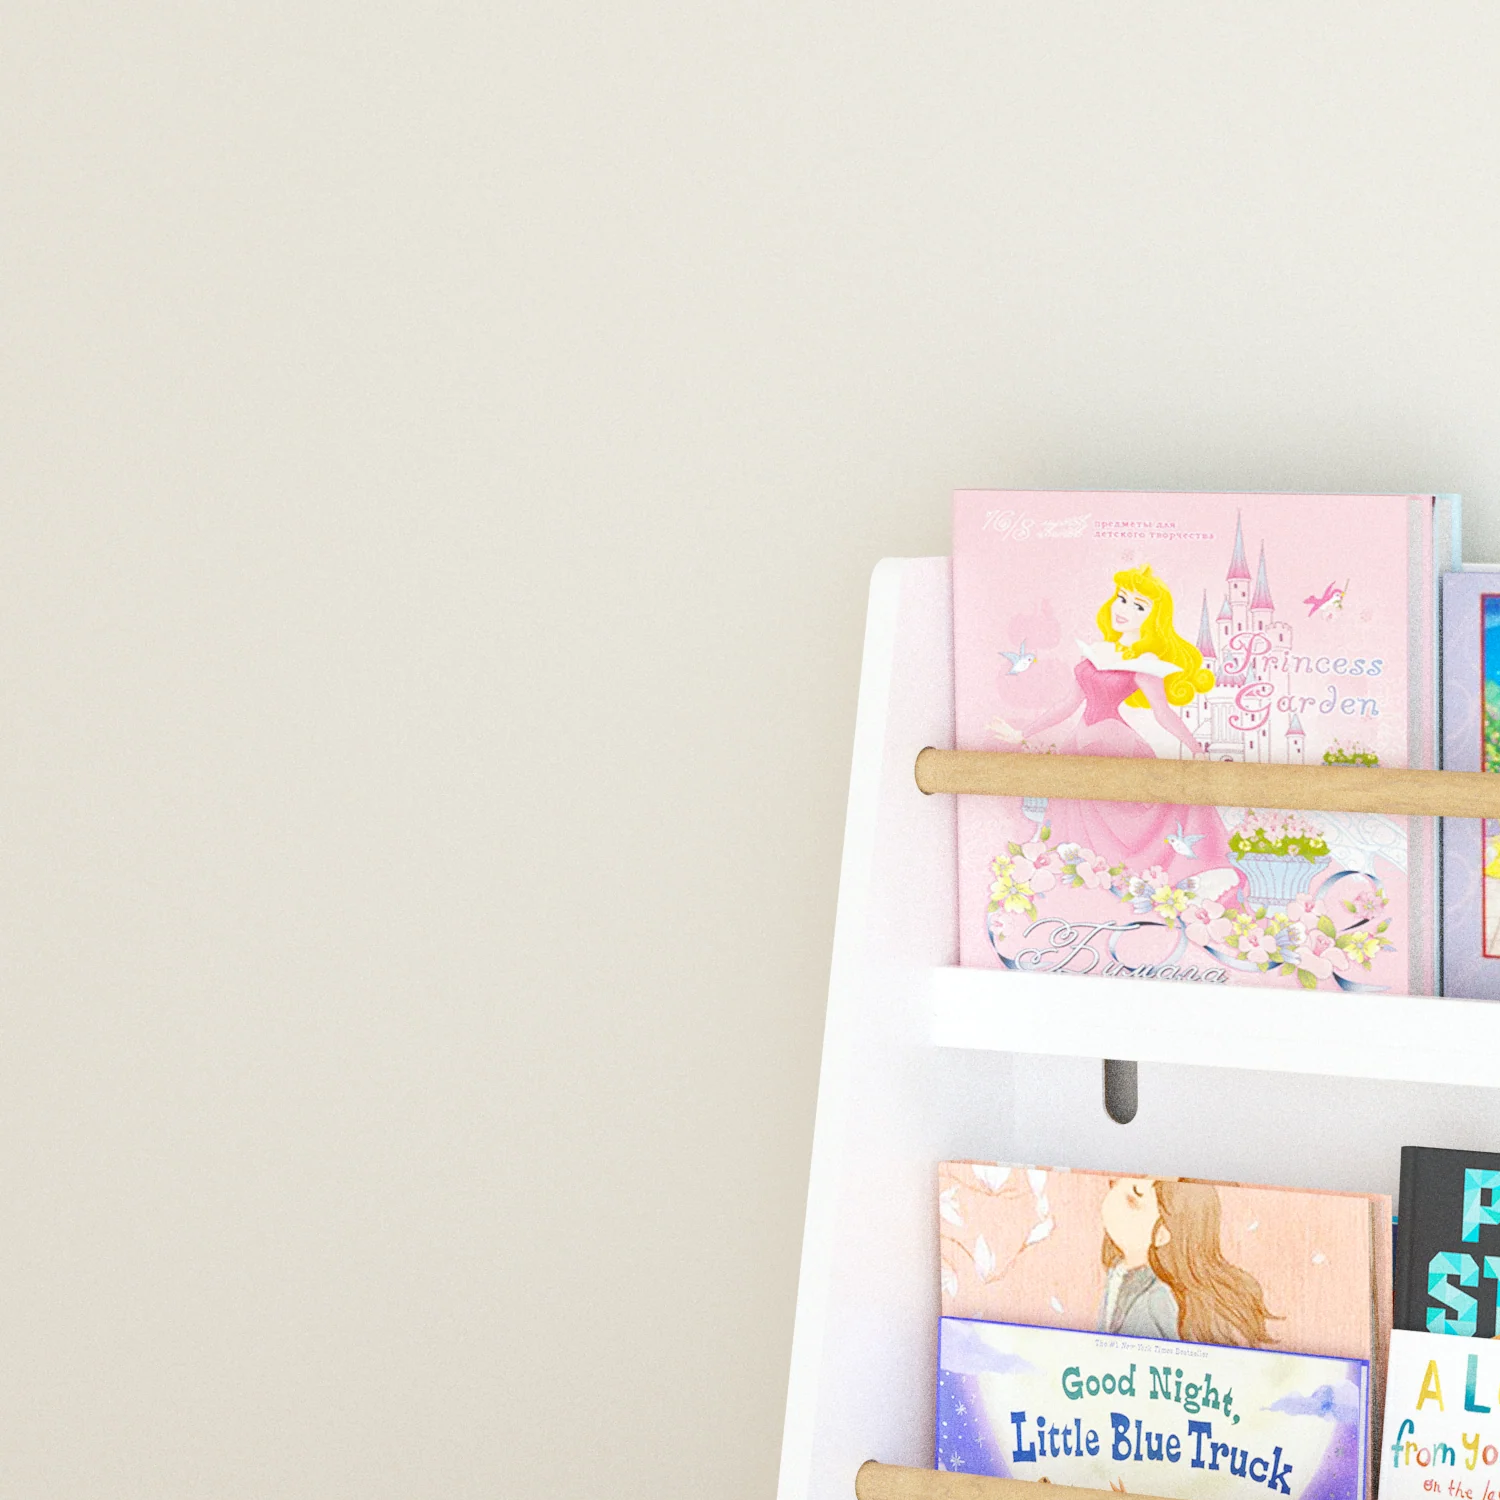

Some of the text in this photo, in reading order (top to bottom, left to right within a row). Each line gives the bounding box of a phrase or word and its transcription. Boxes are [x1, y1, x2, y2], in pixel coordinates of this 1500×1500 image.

[1223, 632, 1384, 676] Princess
[1228, 682, 1380, 731] Garden
[1061, 1363, 1241, 1426] Good Night,
[1415, 1360, 1445, 1412] A
[1010, 1411, 1294, 1496] Little Blue Truck
[1391, 1418, 1456, 1468] from
[1423, 1478, 1442, 1493] on
[1448, 1478, 1474, 1500] the
